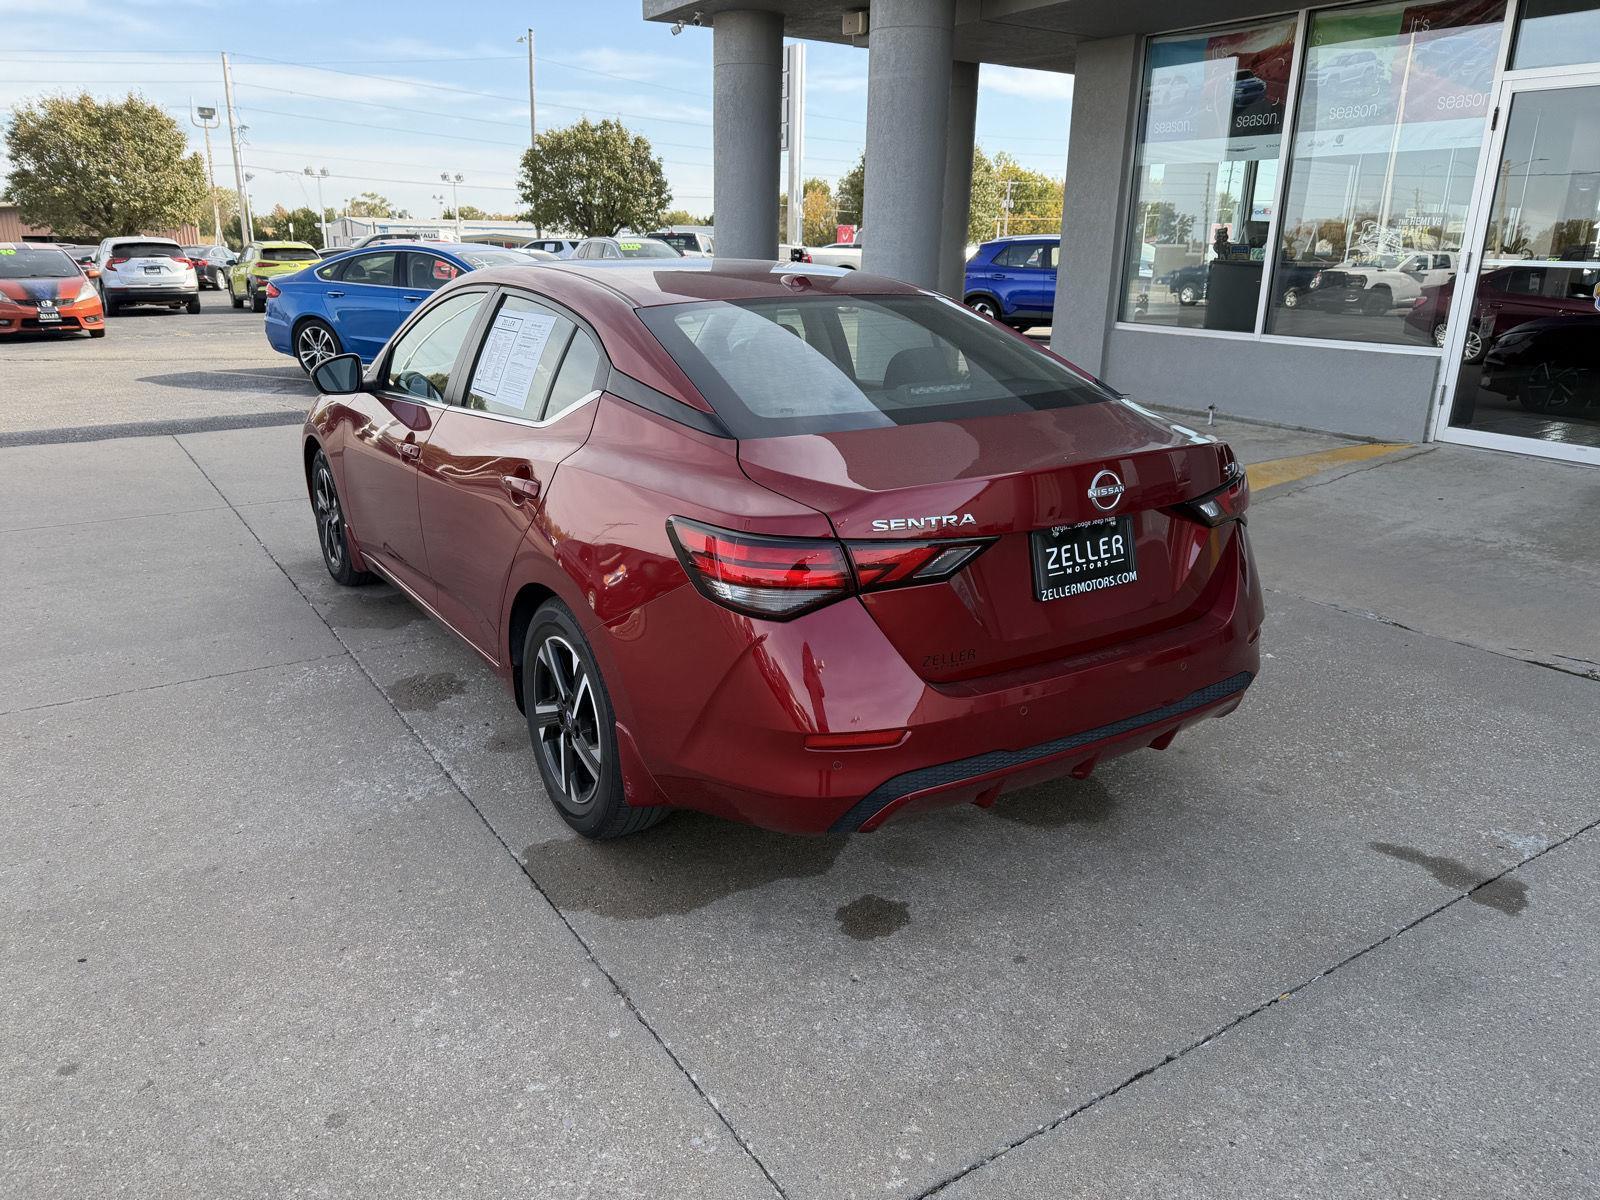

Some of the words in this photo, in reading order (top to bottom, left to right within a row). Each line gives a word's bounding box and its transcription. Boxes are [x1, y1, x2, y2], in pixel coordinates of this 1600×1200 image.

[1154, 120, 1193, 134] season.
[1236, 111, 1280, 128] season.
[1410, 216, 1431, 226] HEMI
[1432, 216, 1443, 226] V8
[1088, 485, 1125, 498] NISSAN
[872, 513, 977, 532] SENTRA
[1046, 534, 1124, 570] ZELLER
[1066, 560, 1109, 575] MOTORS
[1042, 570, 1138, 602] ZELLERMOTORS.COM
[922, 649, 976, 668] ZELLER
